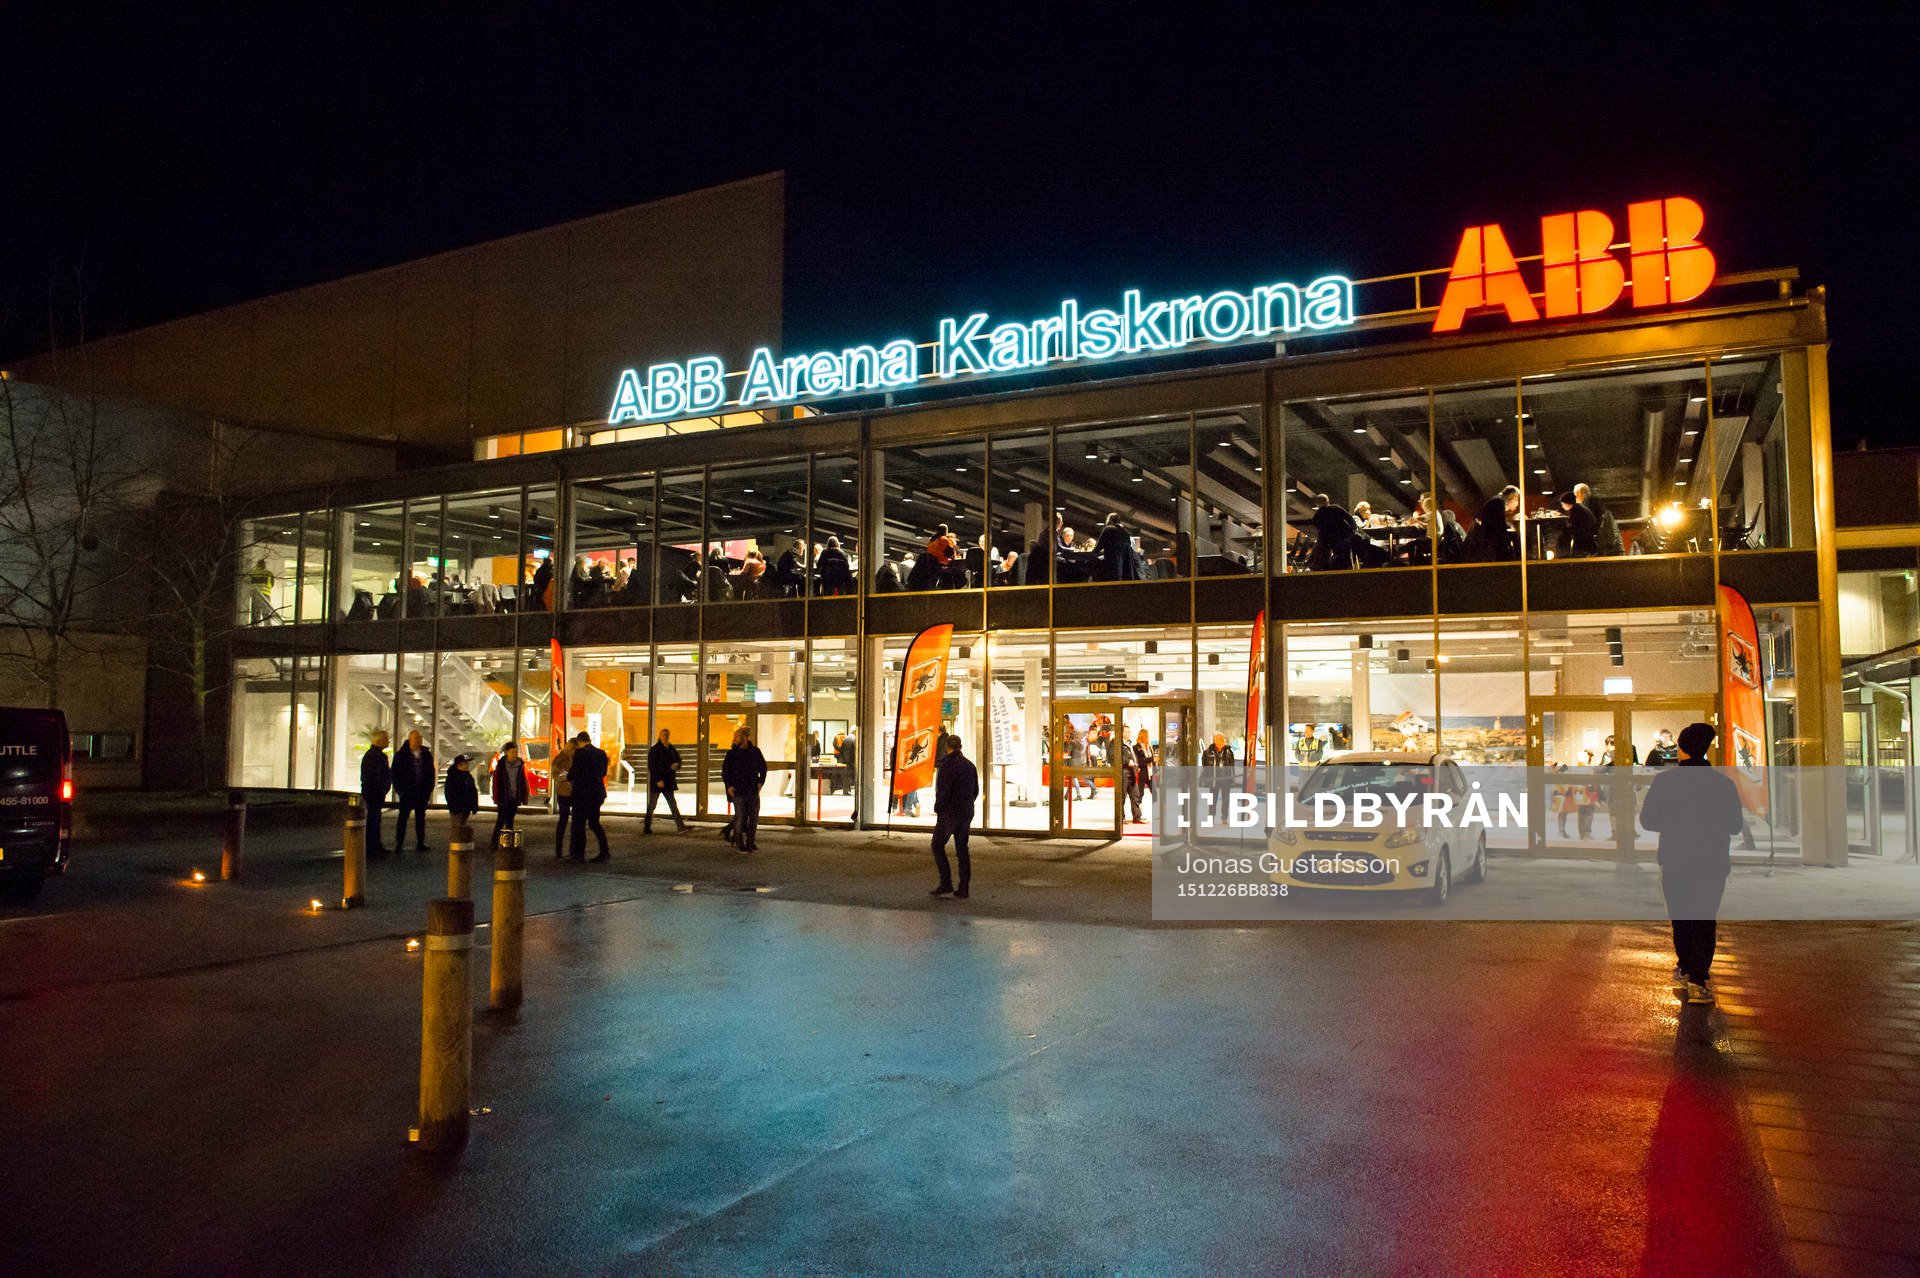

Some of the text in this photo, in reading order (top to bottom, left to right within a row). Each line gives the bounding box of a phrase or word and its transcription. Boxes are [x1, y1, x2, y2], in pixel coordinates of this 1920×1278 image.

[1432, 197, 1716, 333] ABB
[609, 273, 1357, 424] ABB Arena Karlskrona
